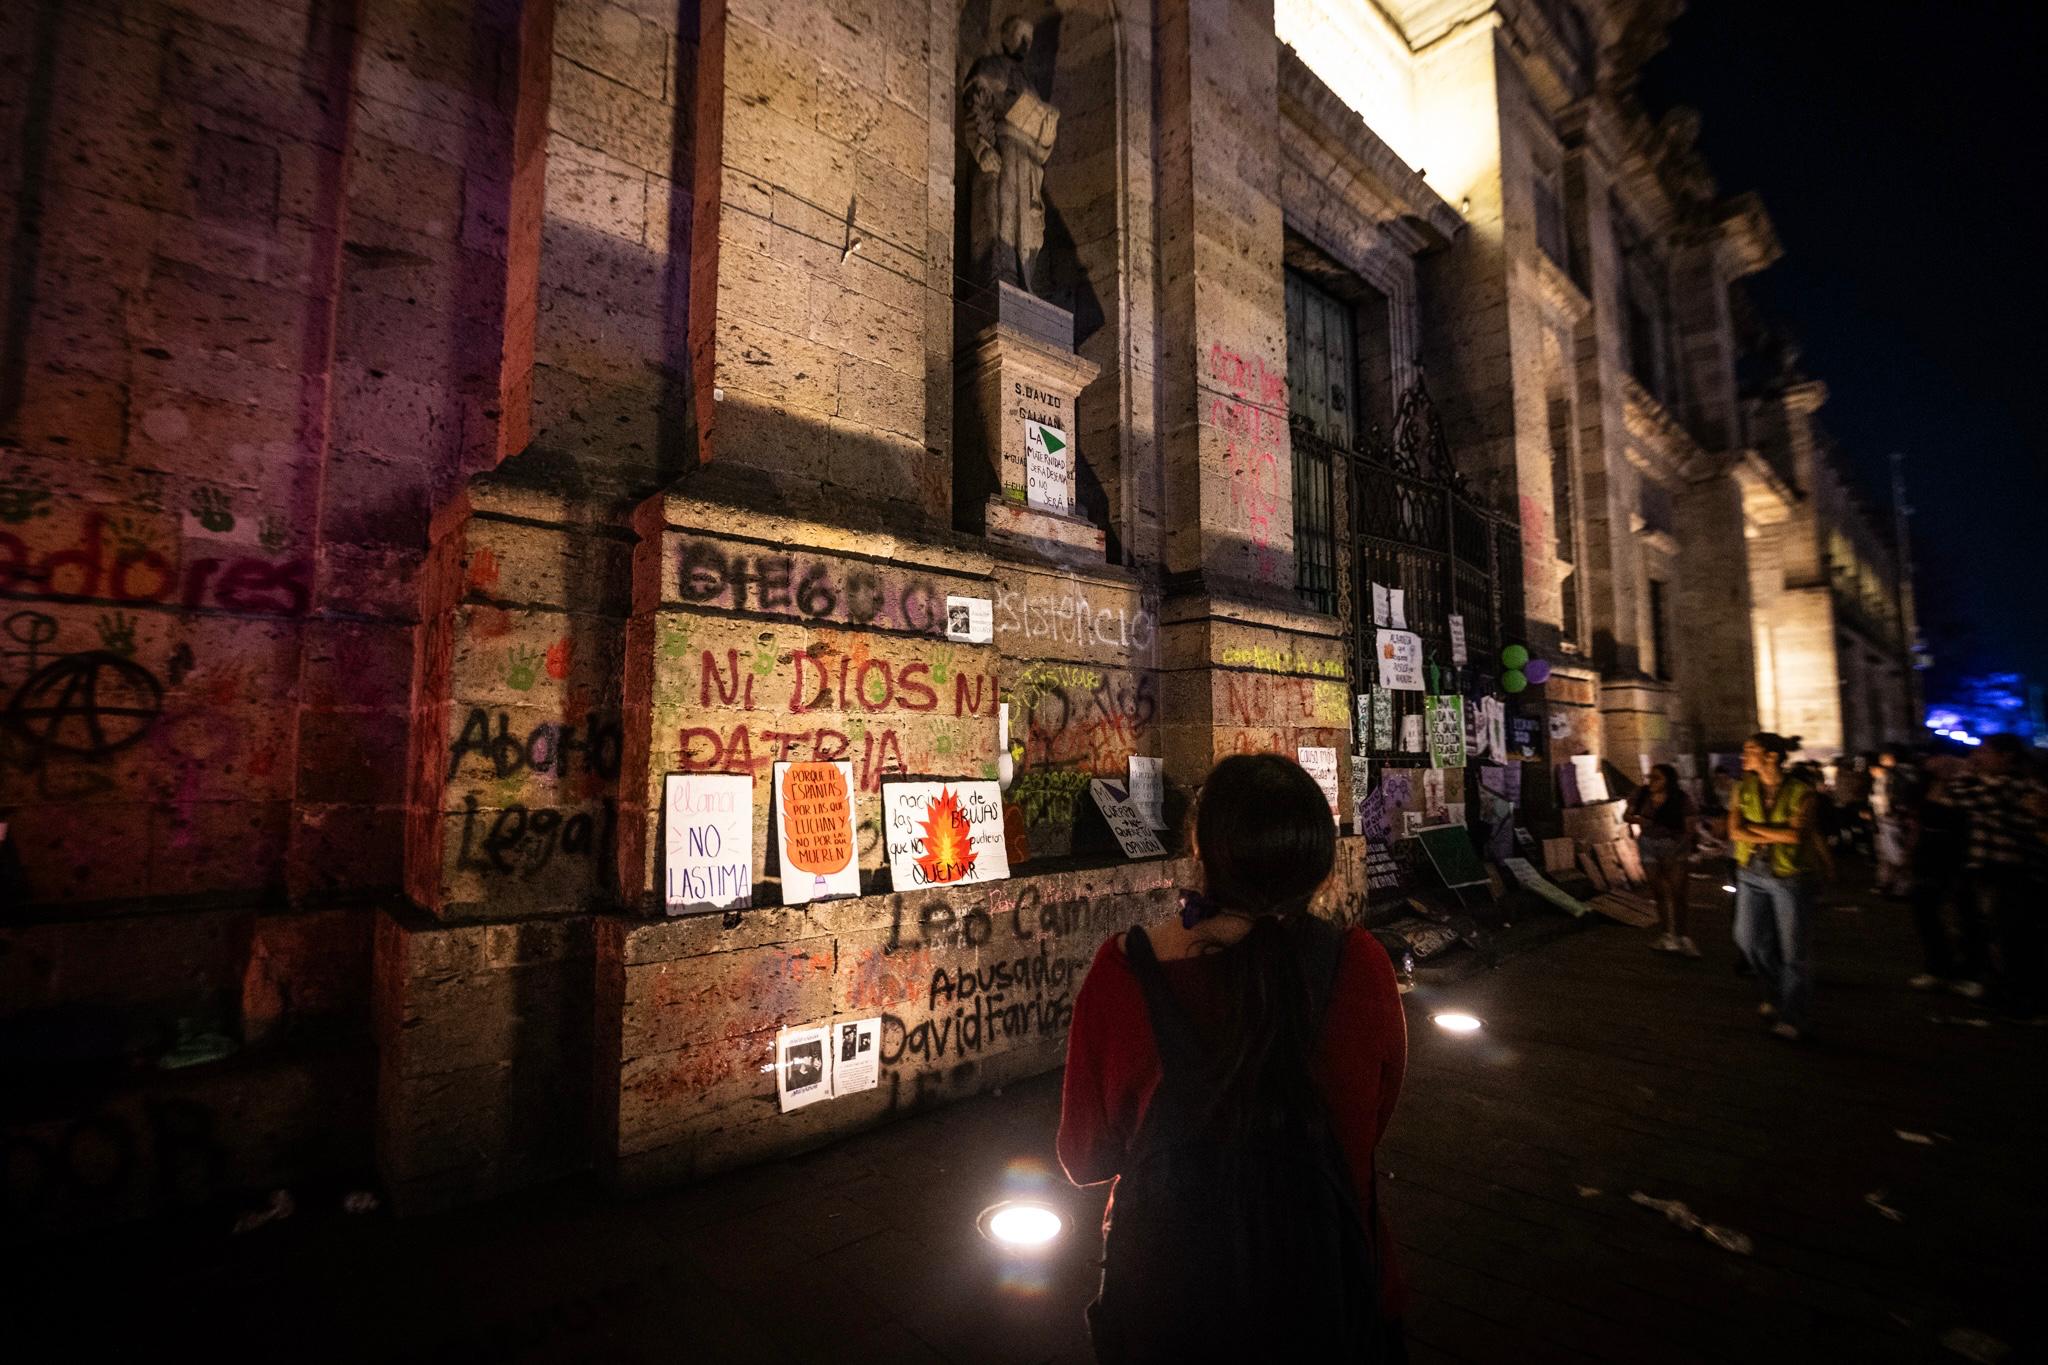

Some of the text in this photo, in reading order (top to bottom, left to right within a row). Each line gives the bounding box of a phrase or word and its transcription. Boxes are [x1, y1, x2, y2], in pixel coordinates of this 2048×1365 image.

[1029, 427, 1043, 446] LA
[789, 650, 938, 714] DIOS
[955, 672, 999, 718] NI
[680, 723, 908, 794] PATRIA
[969, 790, 986, 806] de
[793, 802, 843, 816] POR LAS QUE
[893, 808, 913, 834] las
[951, 801, 998, 829] BRUJAS
[1102, 804, 1136, 819] CUERPO
[795, 816, 846, 835] LUCHAN Y
[689, 824, 721, 857] NO
[796, 838, 809, 848] NO
[814, 836, 831, 846] POR
[798, 849, 845, 864] MUEREN
[890, 840, 907, 866] que
[911, 838, 924, 855] NO
[669, 864, 750, 899] LASTIMA
[912, 861, 980, 885] QUEMAR
